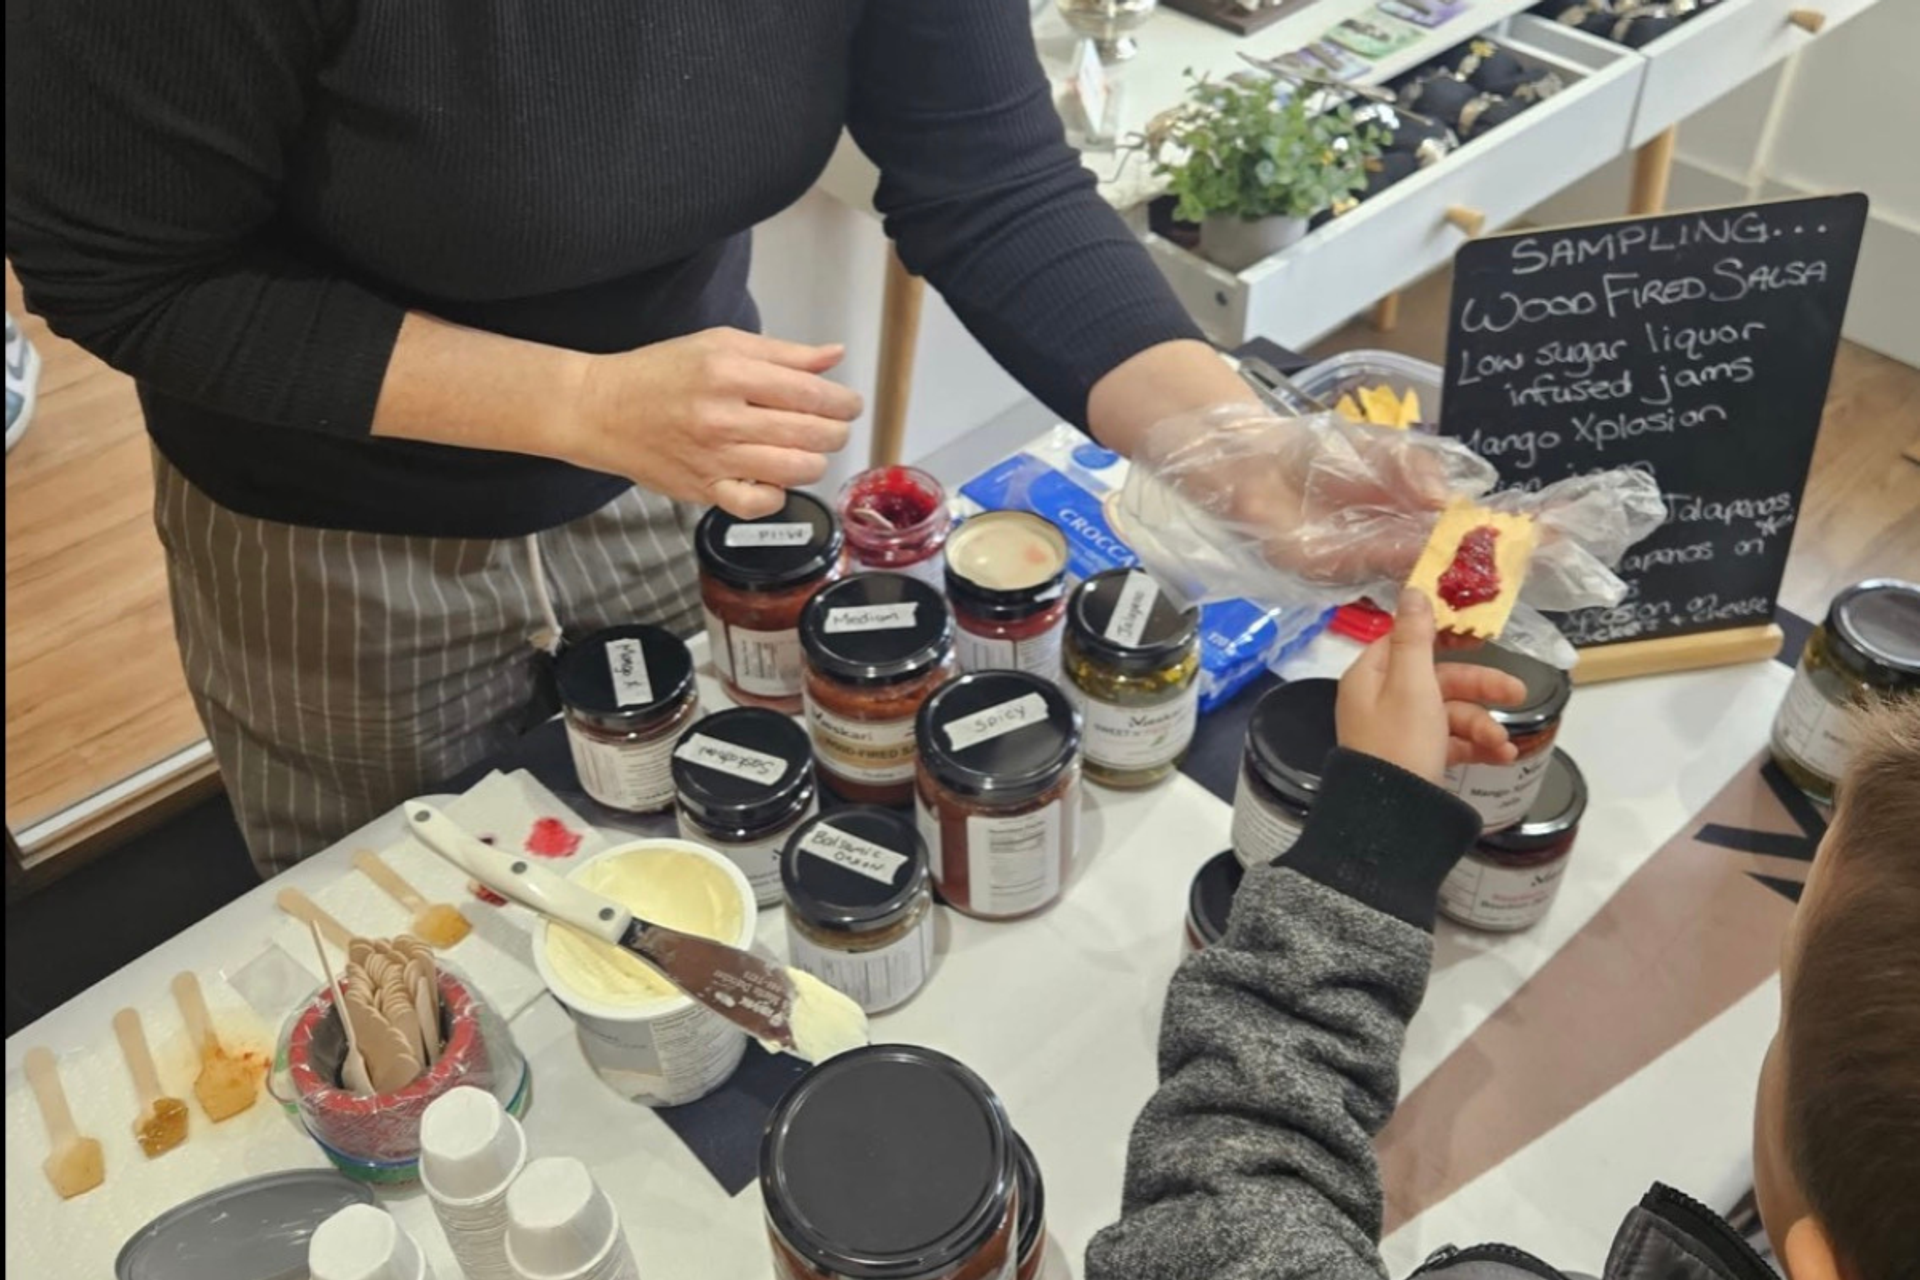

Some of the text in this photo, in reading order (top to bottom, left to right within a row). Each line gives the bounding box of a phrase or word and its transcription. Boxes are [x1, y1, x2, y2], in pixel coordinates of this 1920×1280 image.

[1457, 322, 1766, 386] Low sugar liquor
[1504, 356, 1754, 407] infused jams
